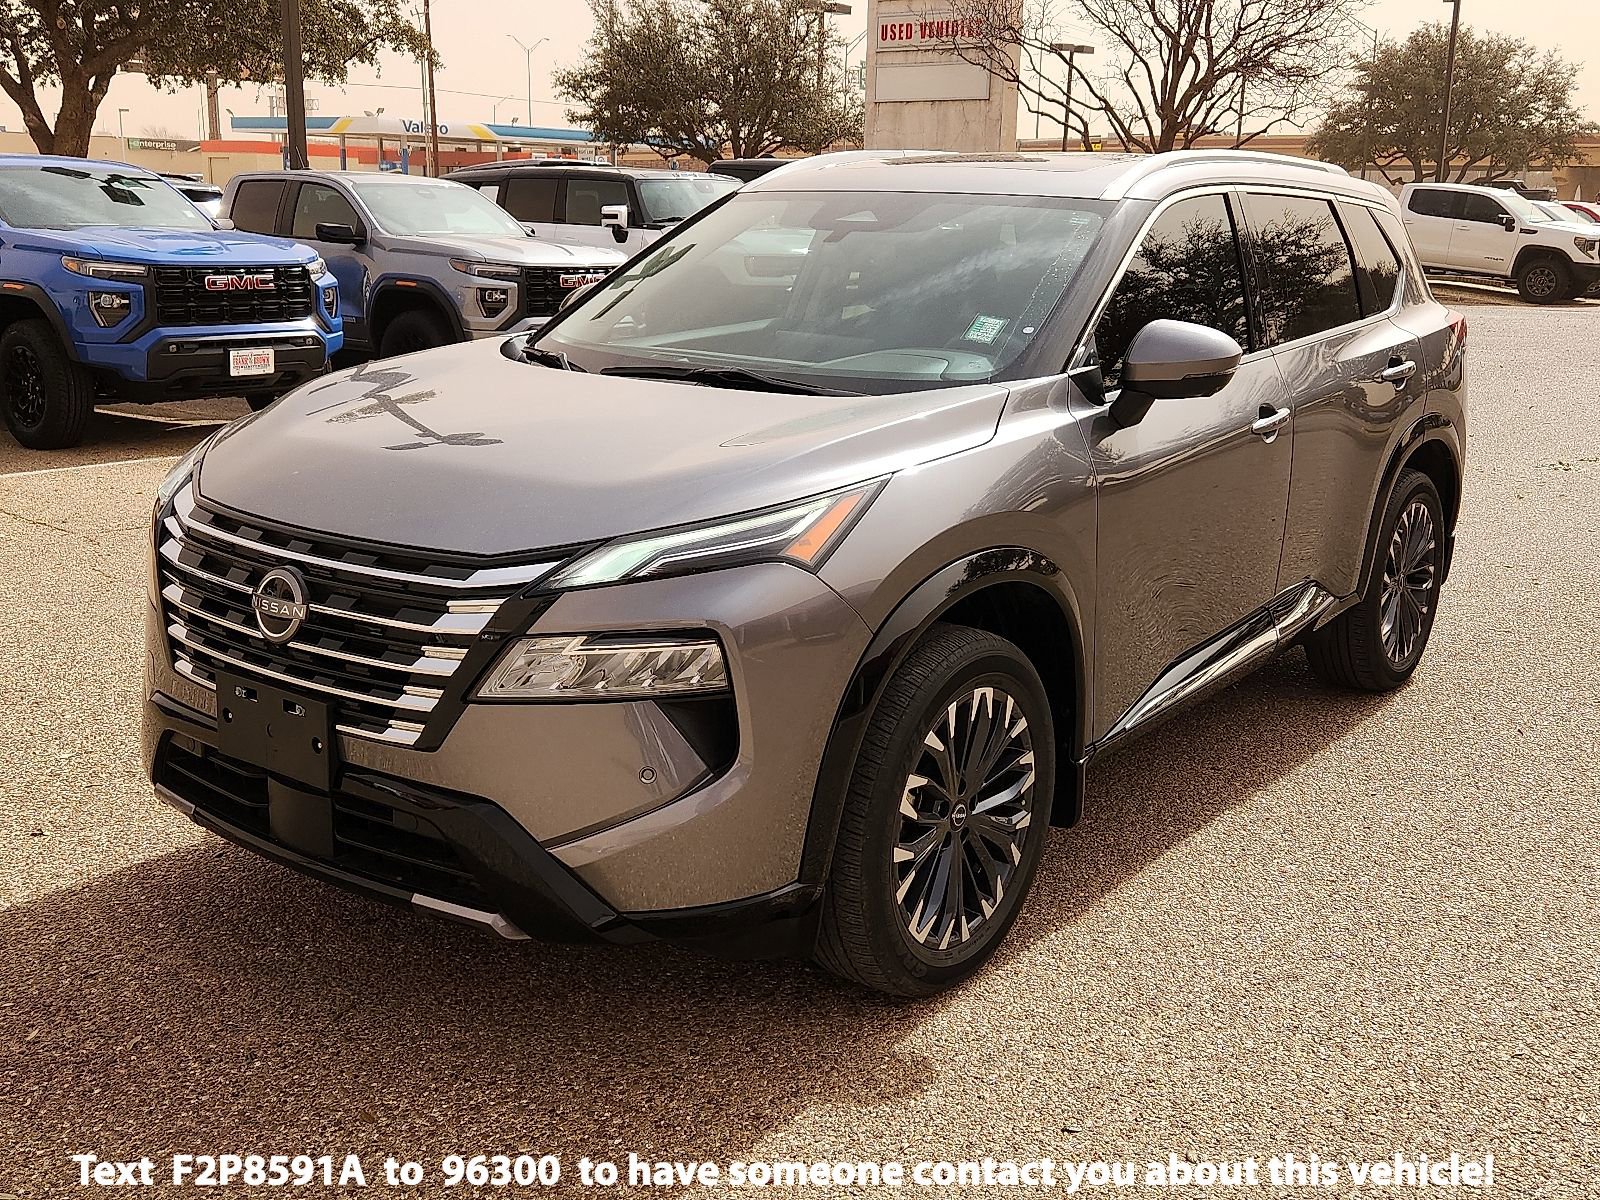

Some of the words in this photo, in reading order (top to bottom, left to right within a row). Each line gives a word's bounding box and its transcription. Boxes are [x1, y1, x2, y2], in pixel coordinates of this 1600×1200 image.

[881, 23, 913, 41] USED
[402, 120, 449, 135] Valeo
[132, 140, 177, 149] enterprise
[205, 275, 276, 291] GMC
[252, 594, 304, 618] NISSAN
